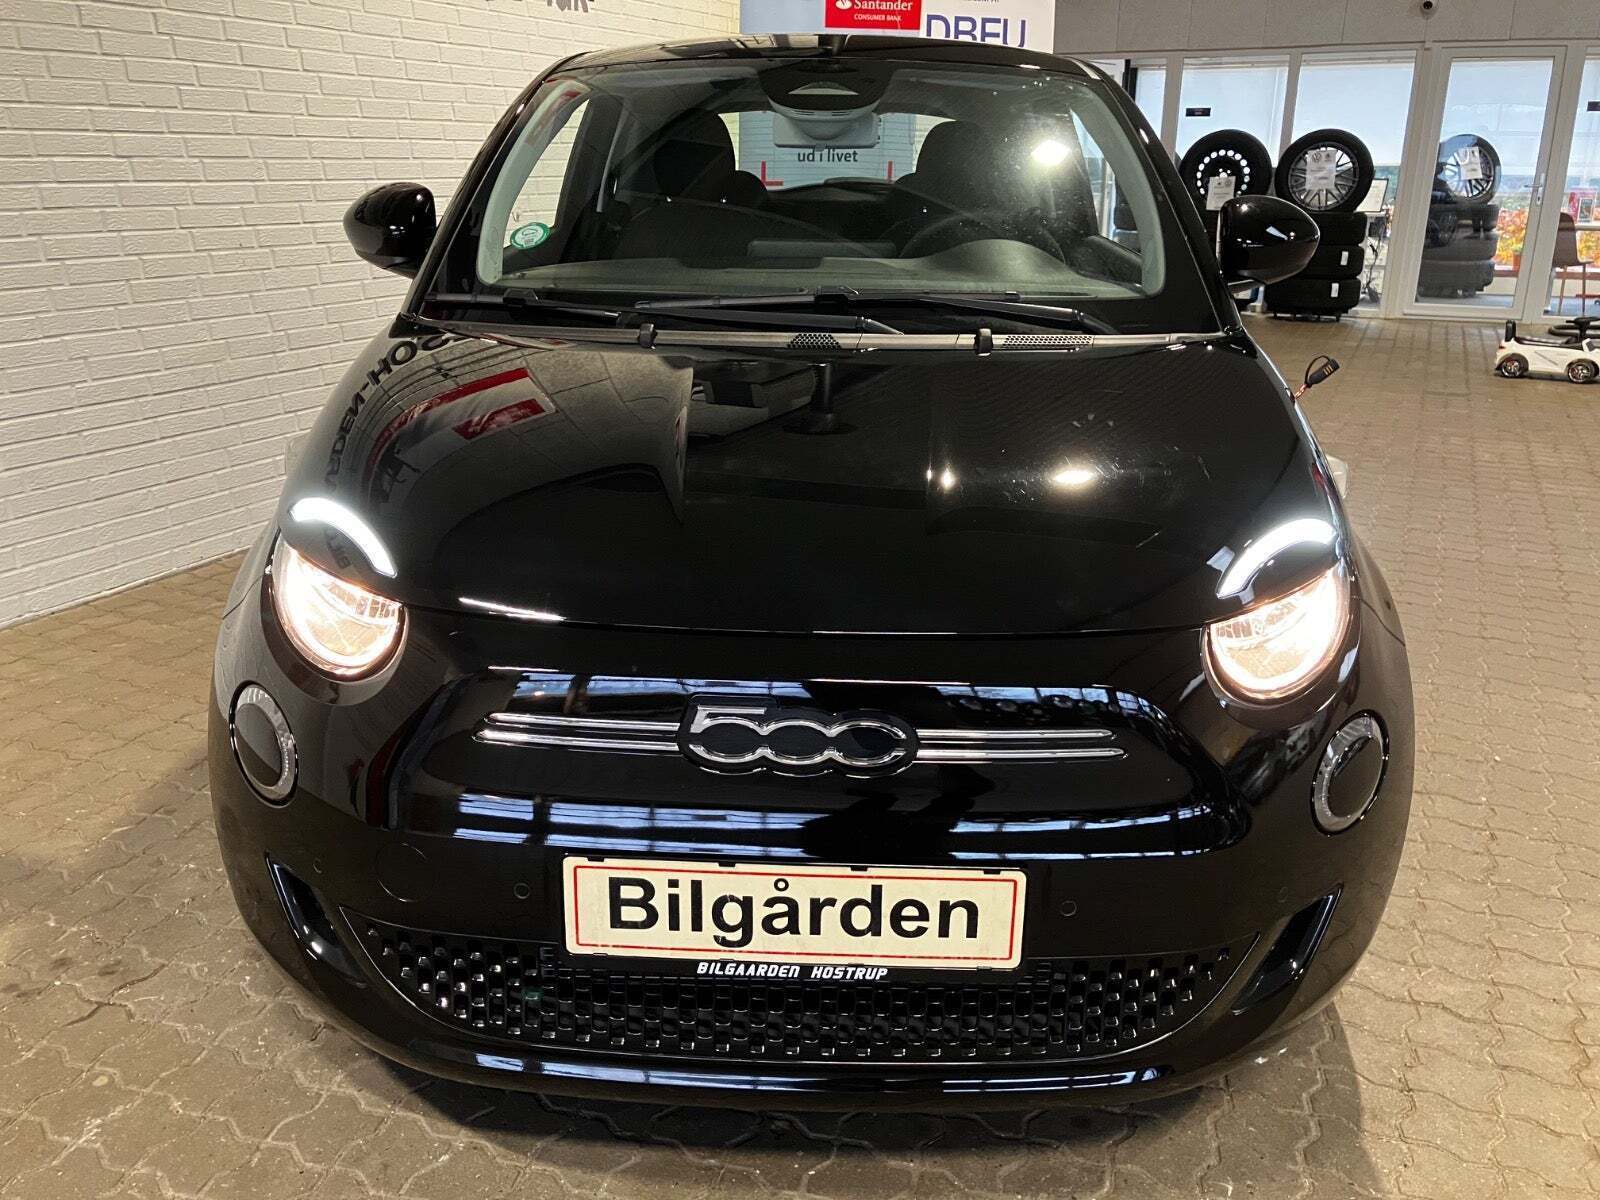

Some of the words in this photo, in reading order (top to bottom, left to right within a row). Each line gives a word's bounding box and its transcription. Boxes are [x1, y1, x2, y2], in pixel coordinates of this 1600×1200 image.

[854, 0, 913, 10] Santander
[854, 13, 885, 21] CONSUMER
[887, 14, 902, 22] BANK
[797, 146, 815, 162] ud
[827, 146, 859, 162] livet
[688, 705, 908, 768] 500
[607, 876, 980, 949] Bilgården
[697, 961, 800, 979] BILGAARDEN
[811, 965, 889, 981] HOSTRUP
